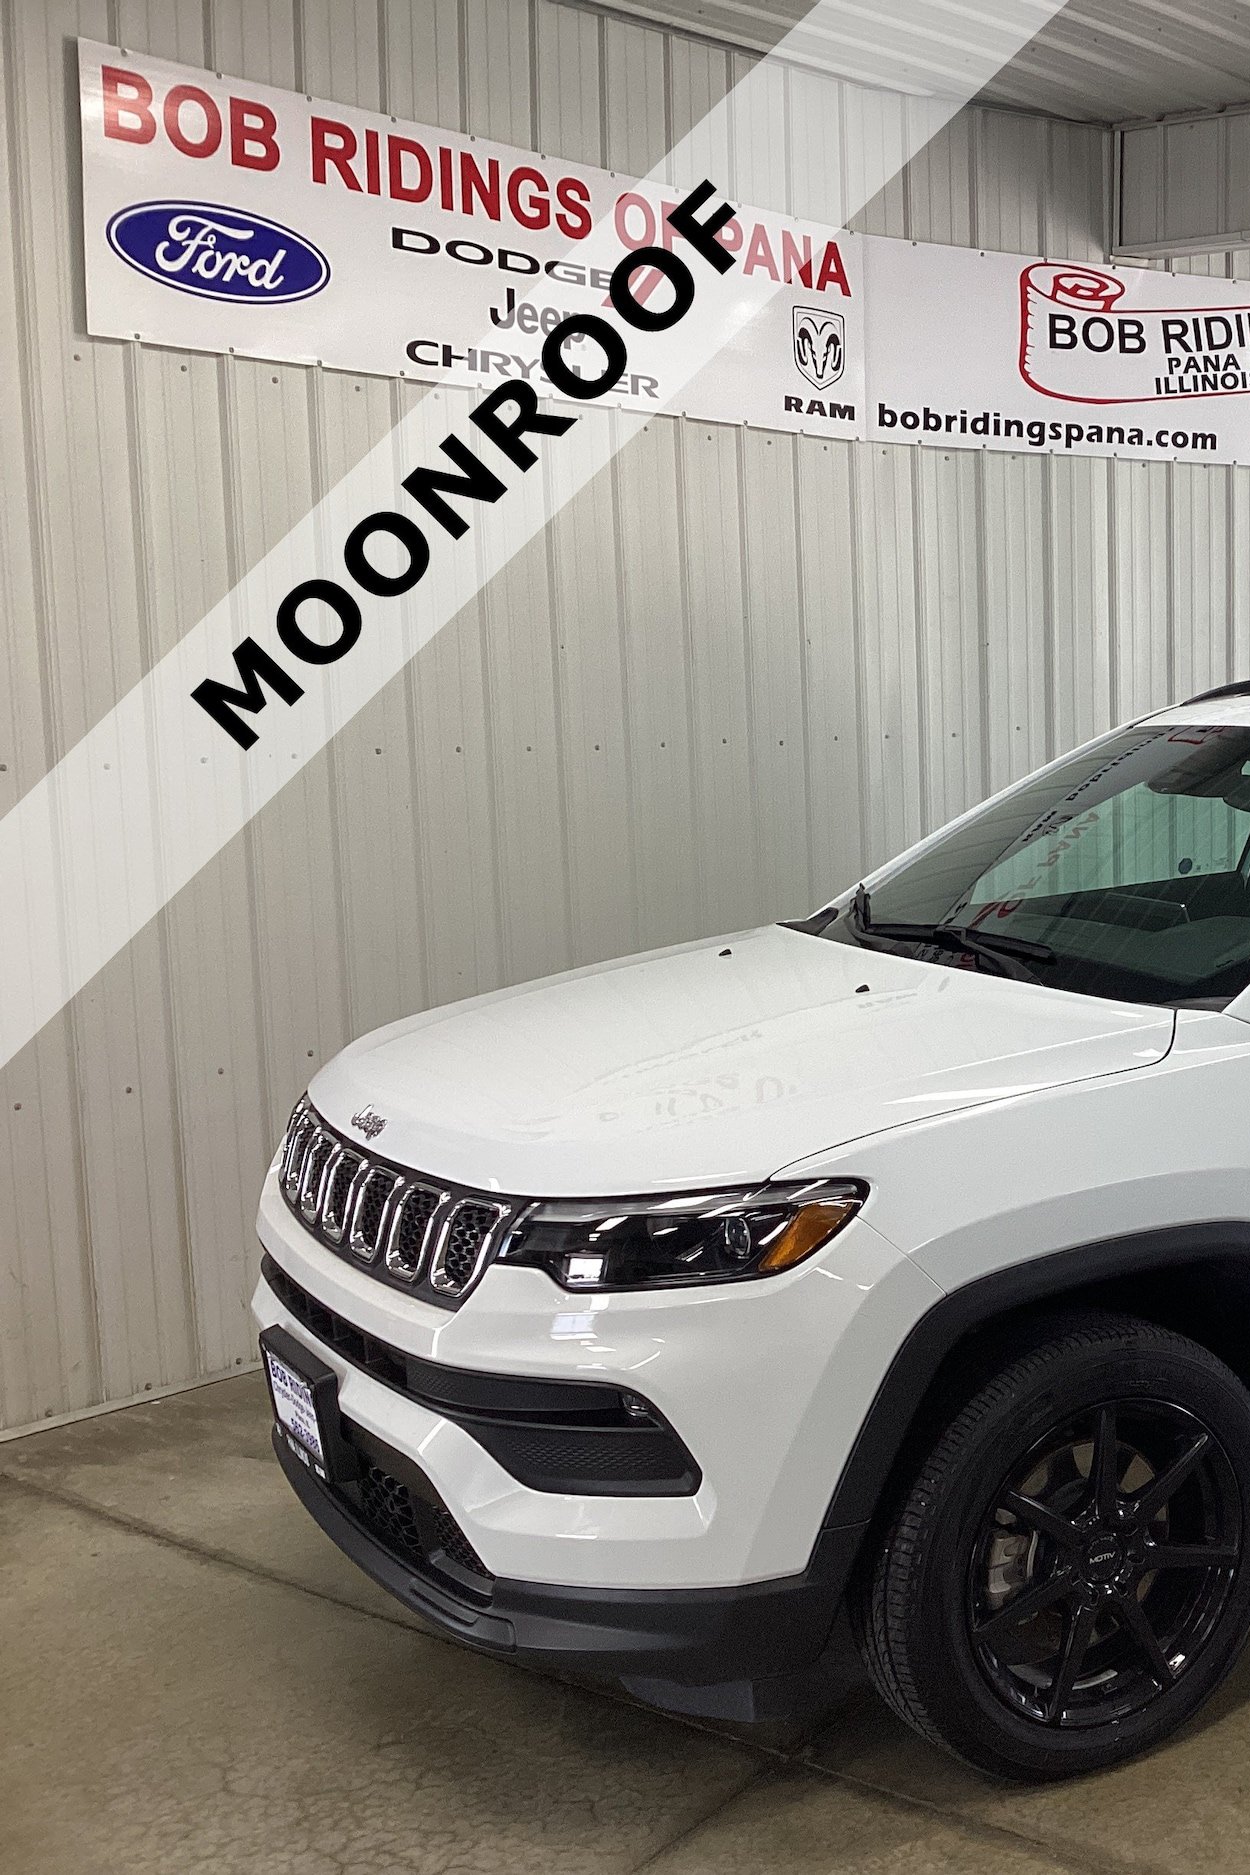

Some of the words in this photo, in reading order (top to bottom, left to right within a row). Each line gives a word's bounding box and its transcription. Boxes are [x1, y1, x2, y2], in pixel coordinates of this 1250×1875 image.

[101, 64, 281, 172] BOB
[310, 115, 593, 240] RIDINGS
[155, 214, 287, 290] Ford
[391, 227, 612, 291] DODGE
[1048, 313, 1147, 354] BOB
[1167, 353, 1241, 375] PANA
[784, 396, 856, 421] RAM
[878, 404, 1218, 450] bobridingspana.com
[1090, 1551, 1116, 1565] MOTIV
